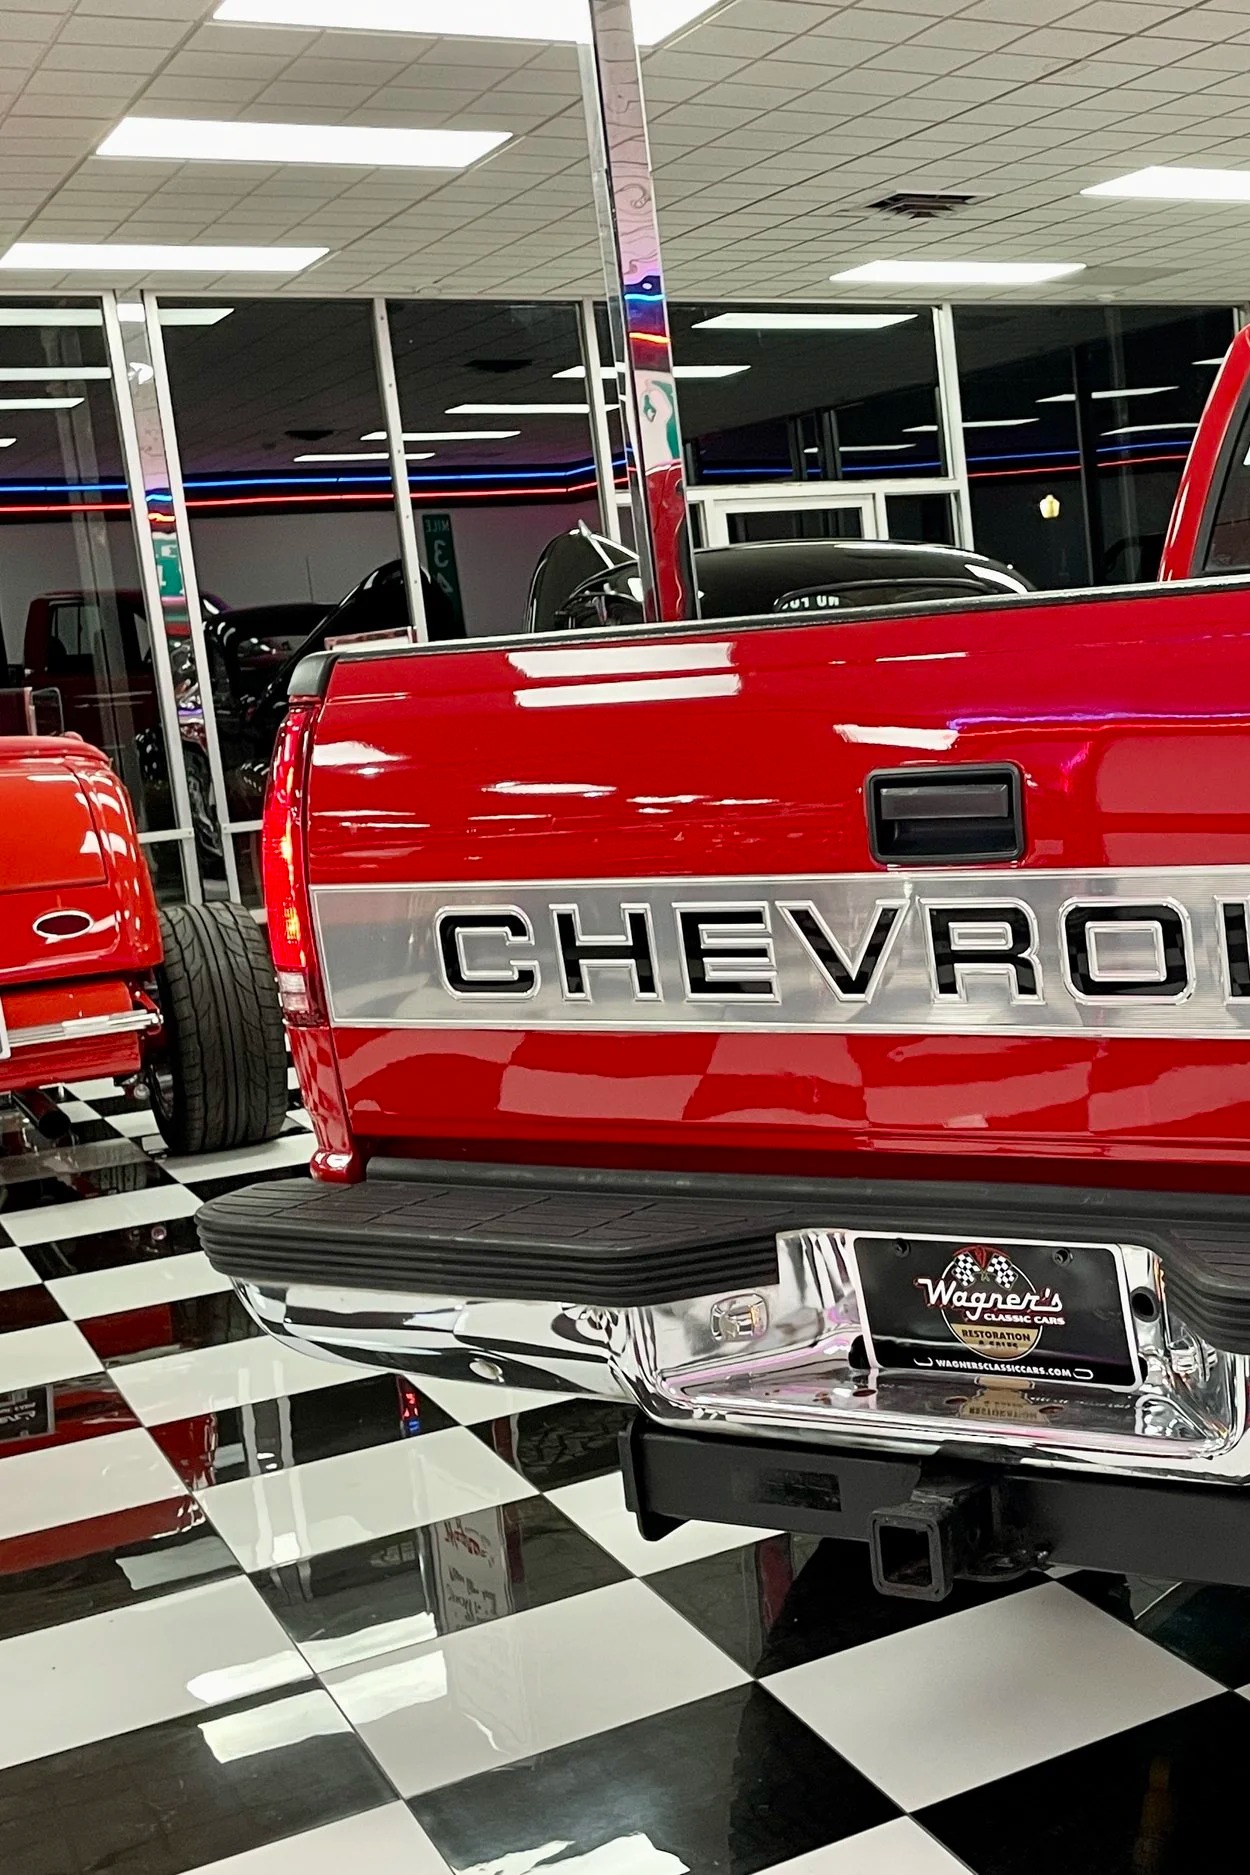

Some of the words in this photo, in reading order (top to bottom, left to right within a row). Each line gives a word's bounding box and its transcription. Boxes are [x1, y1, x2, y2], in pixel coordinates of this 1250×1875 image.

[916, 1278, 1063, 1322] Wagner's
[983, 1313, 1032, 1324] CLASSIC
[1034, 1316, 1066, 1326] CARS
[961, 1328, 1031, 1342] RESTORATION
[935, 1359, 1072, 1378] WAGNERSCLASSICCARS.COM
